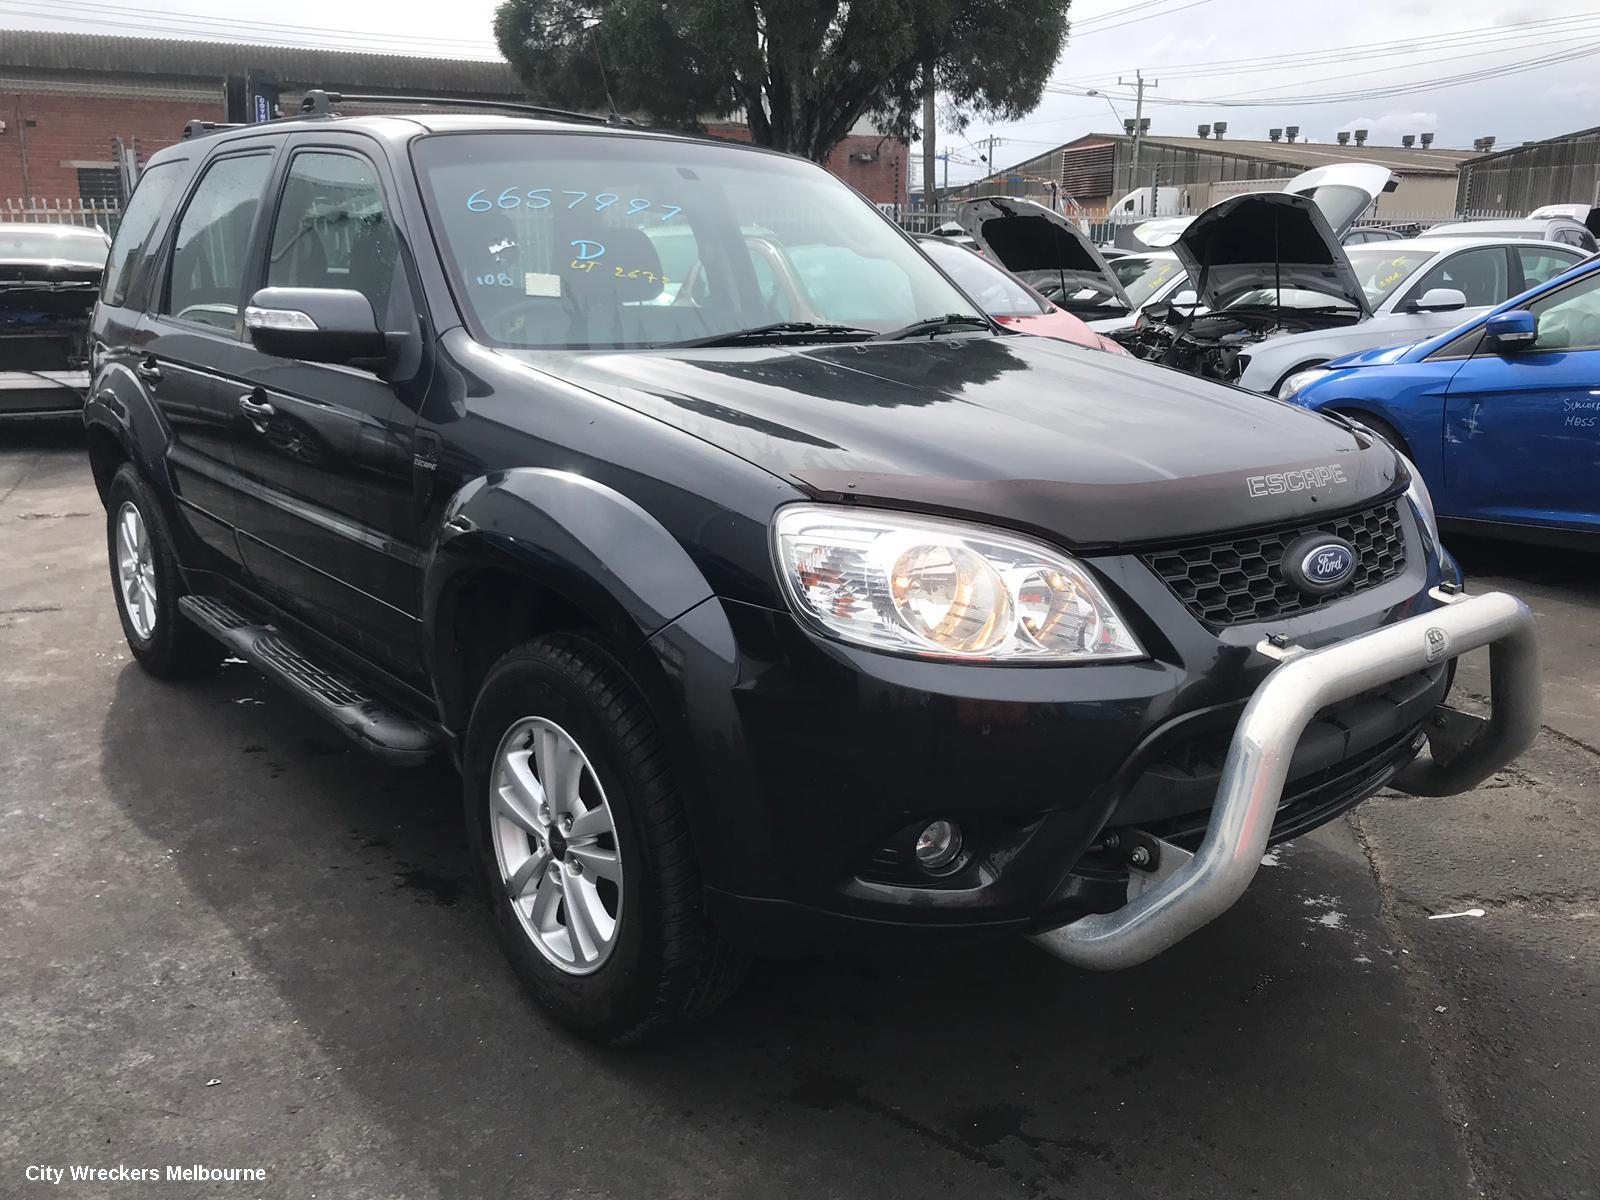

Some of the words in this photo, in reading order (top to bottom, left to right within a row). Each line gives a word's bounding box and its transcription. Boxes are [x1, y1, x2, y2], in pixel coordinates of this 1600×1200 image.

[570, 240, 605, 259] D
[1246, 464, 1348, 497] ESCAPE
[1317, 552, 1343, 574] Ford
